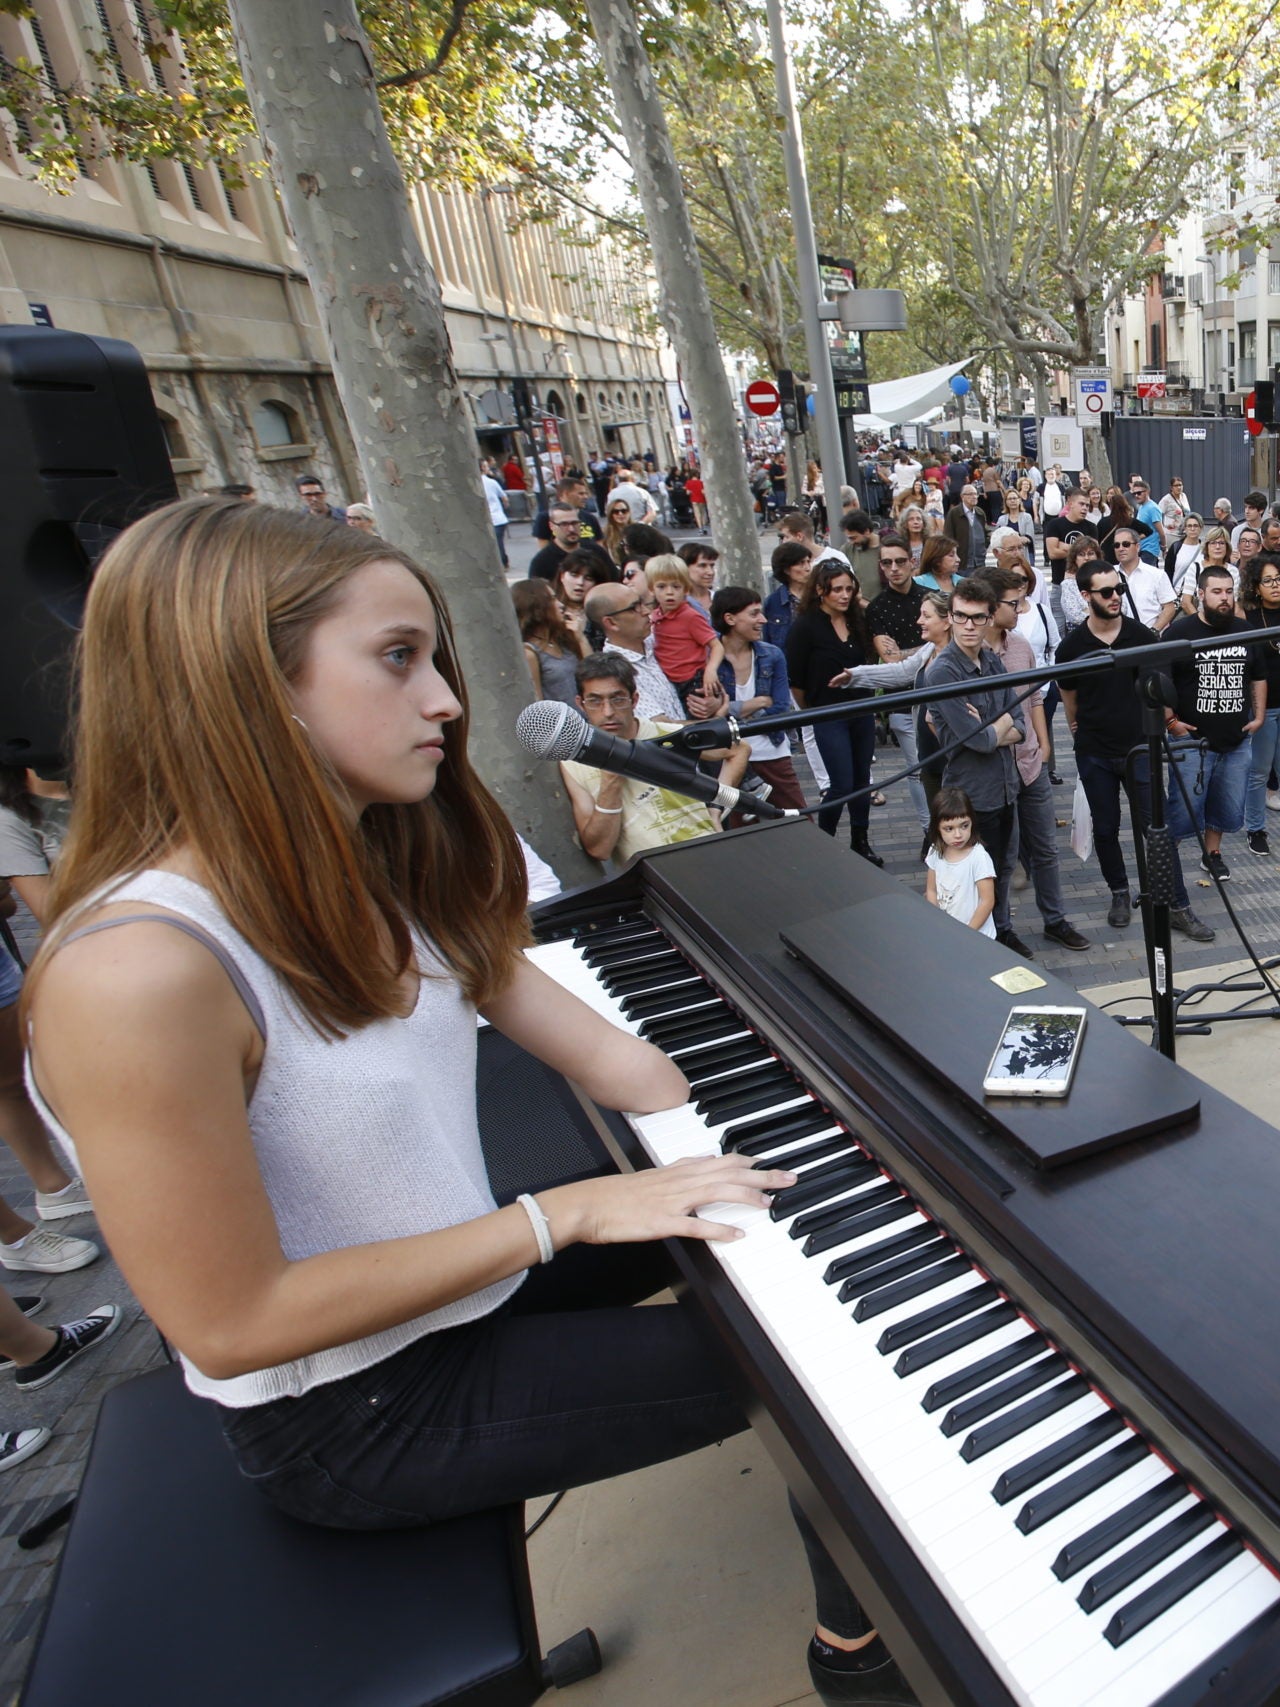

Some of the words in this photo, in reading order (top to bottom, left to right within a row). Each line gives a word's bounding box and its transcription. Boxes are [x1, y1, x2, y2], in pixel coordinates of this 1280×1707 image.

[1216, 662, 1245, 676] TRISTE
[1198, 675, 1227, 689] SERÍA
[1227, 675, 1243, 689] SER
[1197, 688, 1217, 698] COMO
[1218, 688, 1243, 699] QUIEREN
[1196, 698, 1218, 713] QUE
